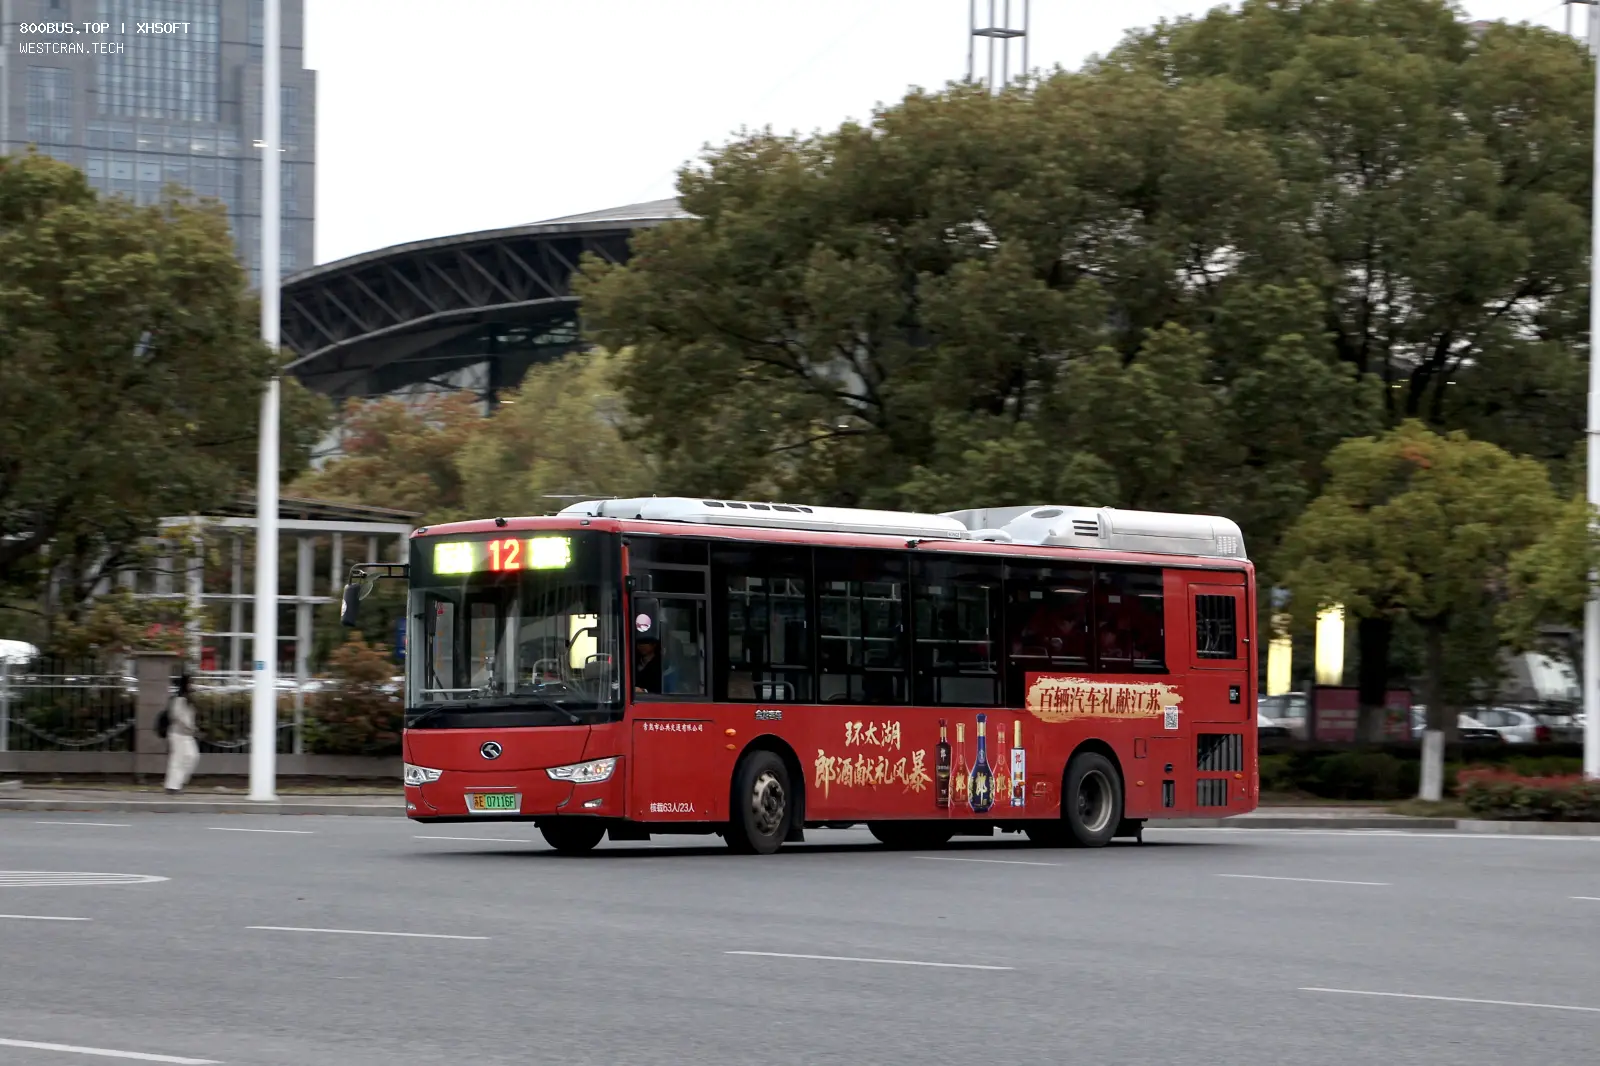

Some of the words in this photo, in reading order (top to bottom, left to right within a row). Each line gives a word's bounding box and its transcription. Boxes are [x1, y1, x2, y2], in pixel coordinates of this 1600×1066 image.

[489, 538, 520, 571] 12
[1039, 686, 1161, 715] 百辆汽车礼献江苏
[844, 720, 901, 752] 环太湖
[814, 748, 933, 800] 郎酒献礼风暴
